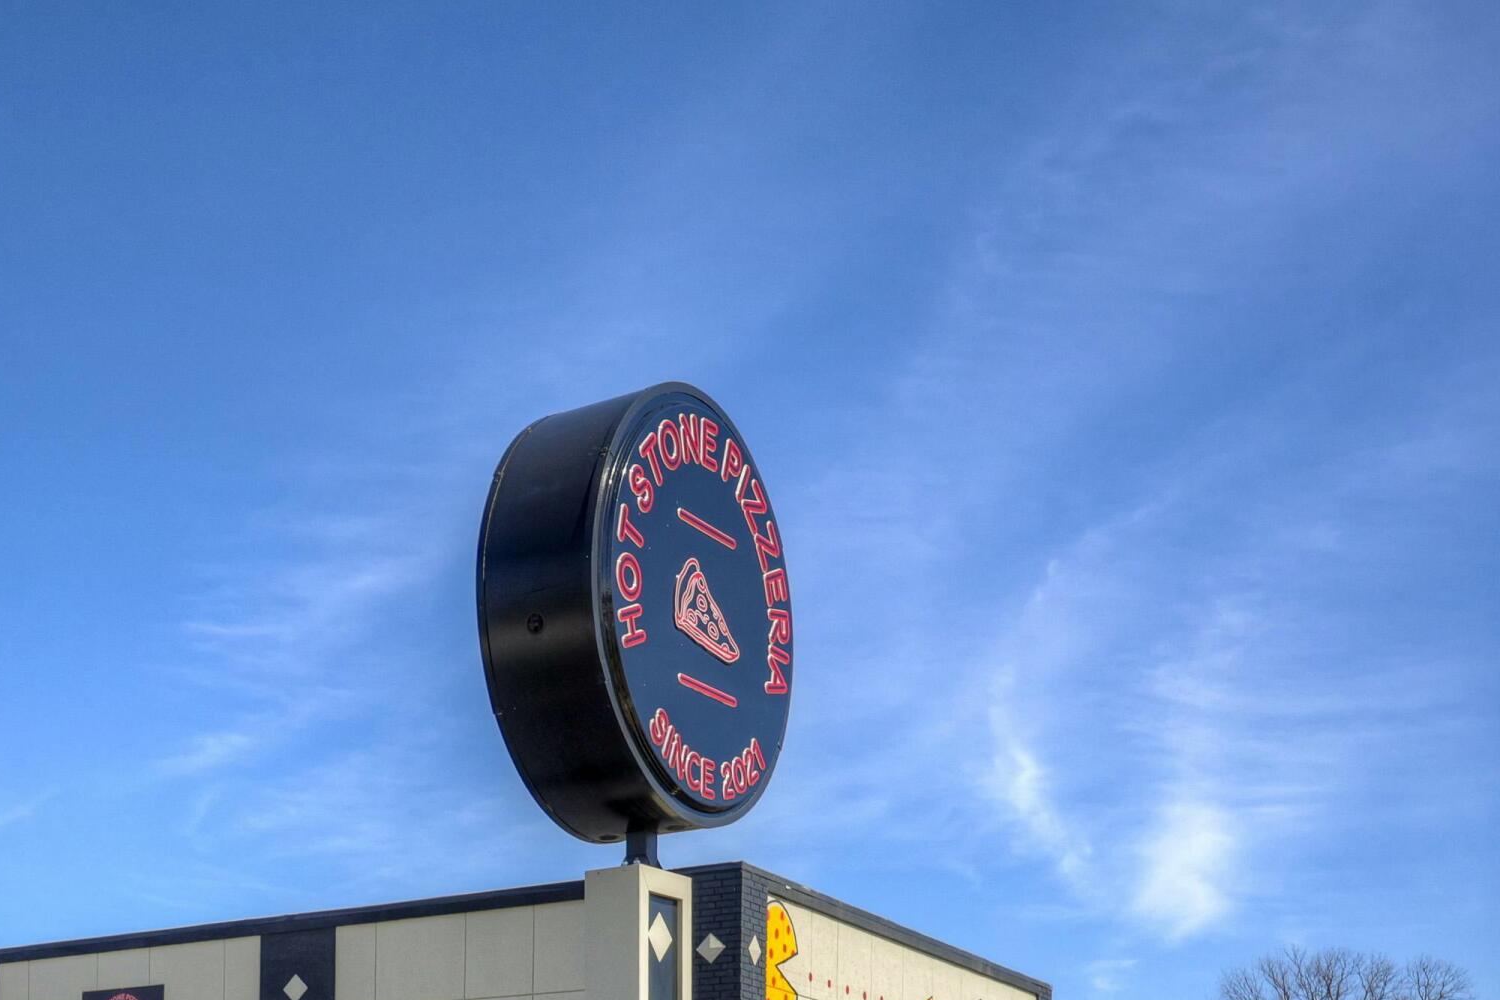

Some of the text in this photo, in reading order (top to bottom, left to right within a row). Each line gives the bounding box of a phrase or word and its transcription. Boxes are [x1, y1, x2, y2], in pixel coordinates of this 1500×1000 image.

[616, 412, 793, 696] HOT STONE PIZZERIA
[649, 707, 765, 800] SINCE 2021
